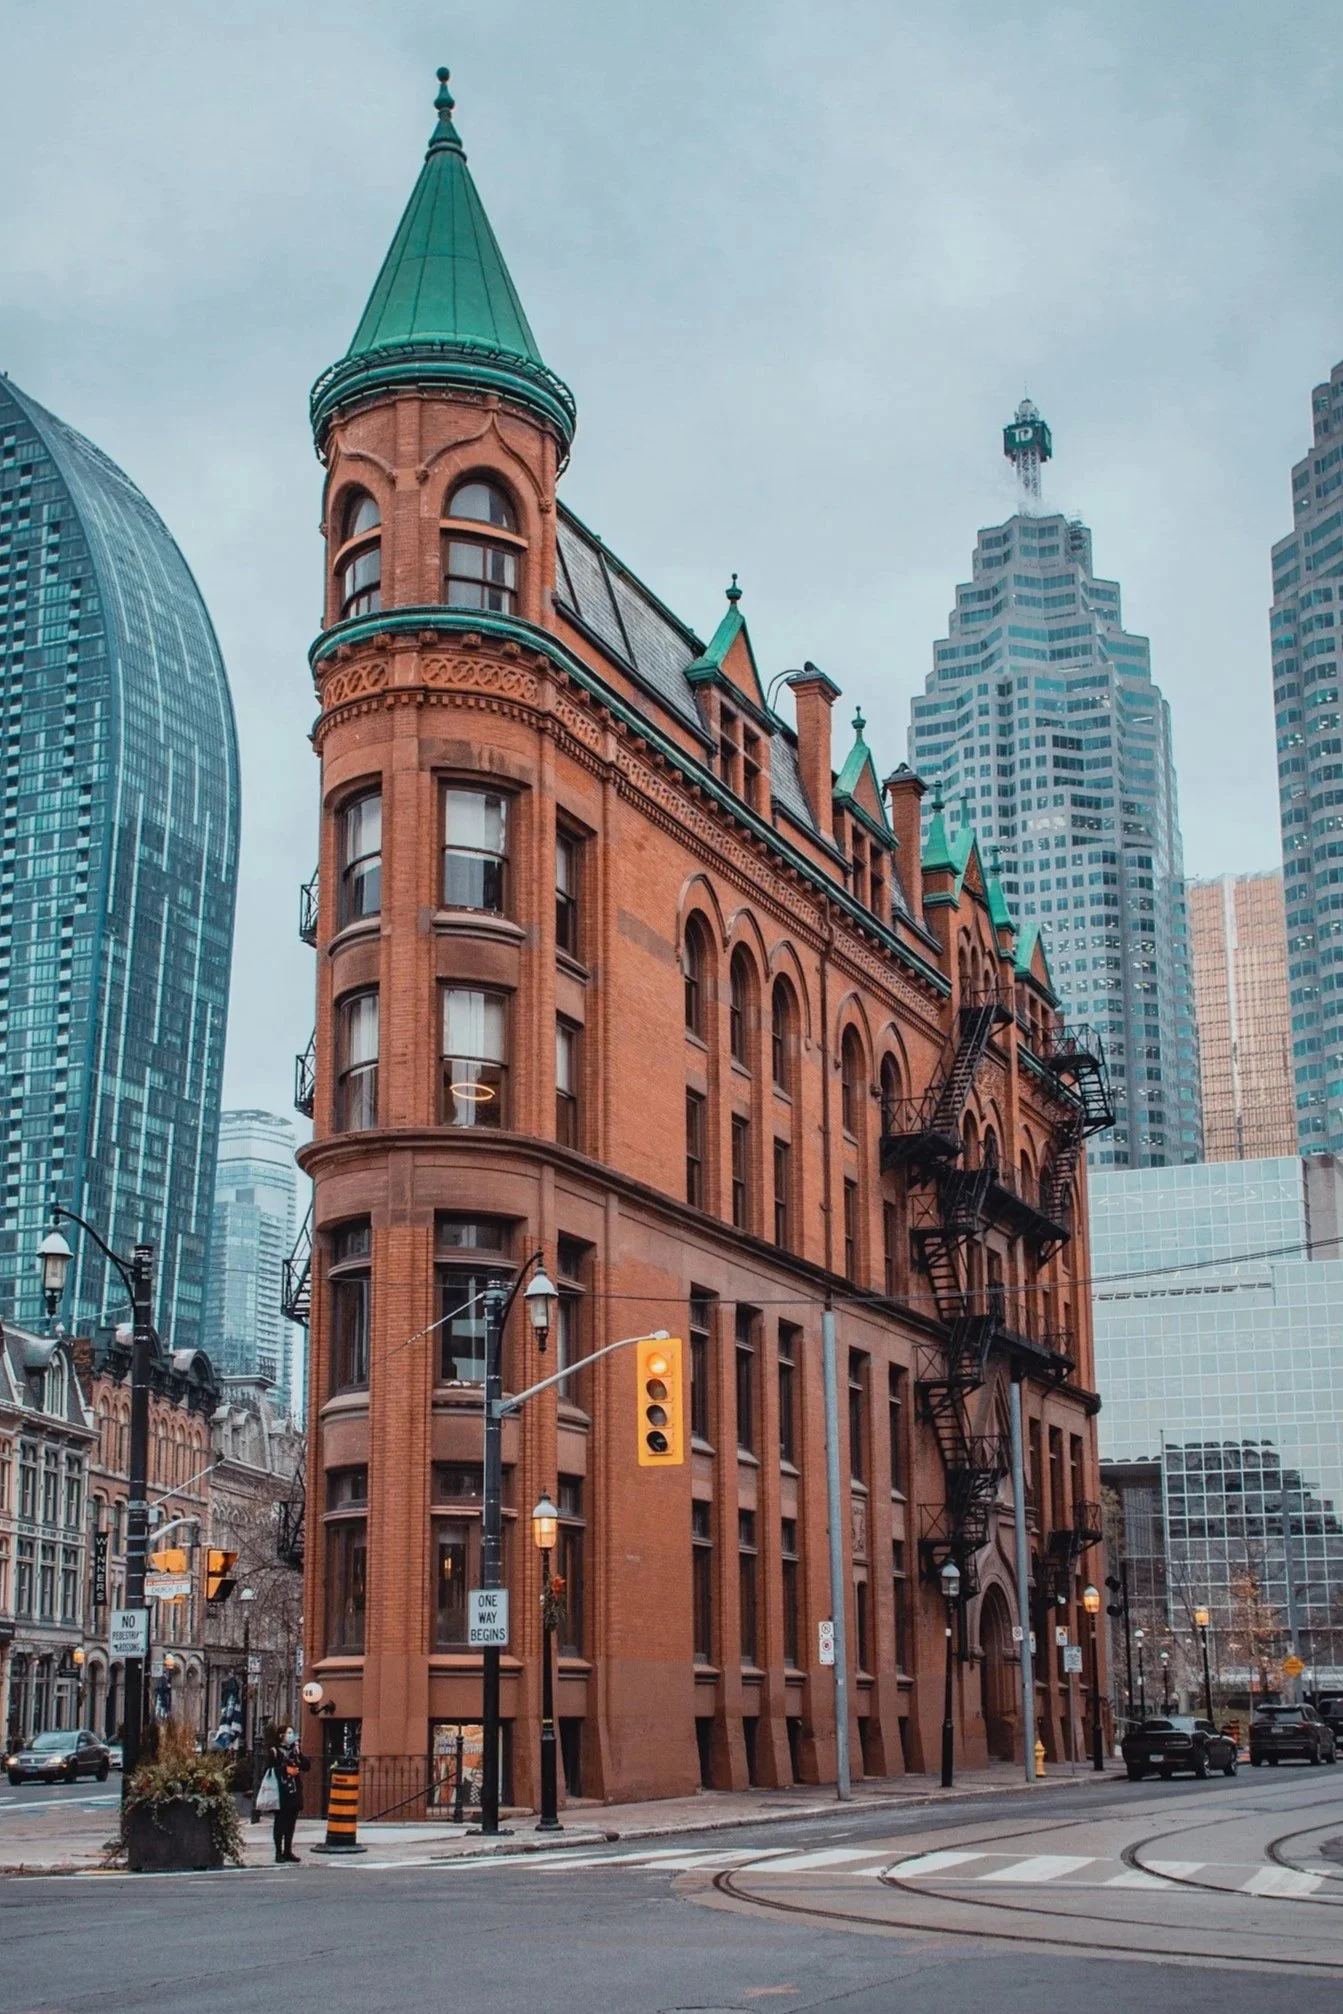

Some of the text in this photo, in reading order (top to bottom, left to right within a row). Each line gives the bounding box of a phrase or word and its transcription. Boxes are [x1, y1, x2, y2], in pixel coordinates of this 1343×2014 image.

[1011, 428, 1033, 442] TD
[96, 1538, 107, 1601] WINNERS
[151, 1586, 173, 1594] CHURCH
[478, 1594, 499, 1607] ONE
[122, 1614, 135, 1628] NO
[478, 1611, 498, 1624] WAY
[112, 1631, 144, 1641] PEDESTRI
[471, 1627, 506, 1641] BEGINS
